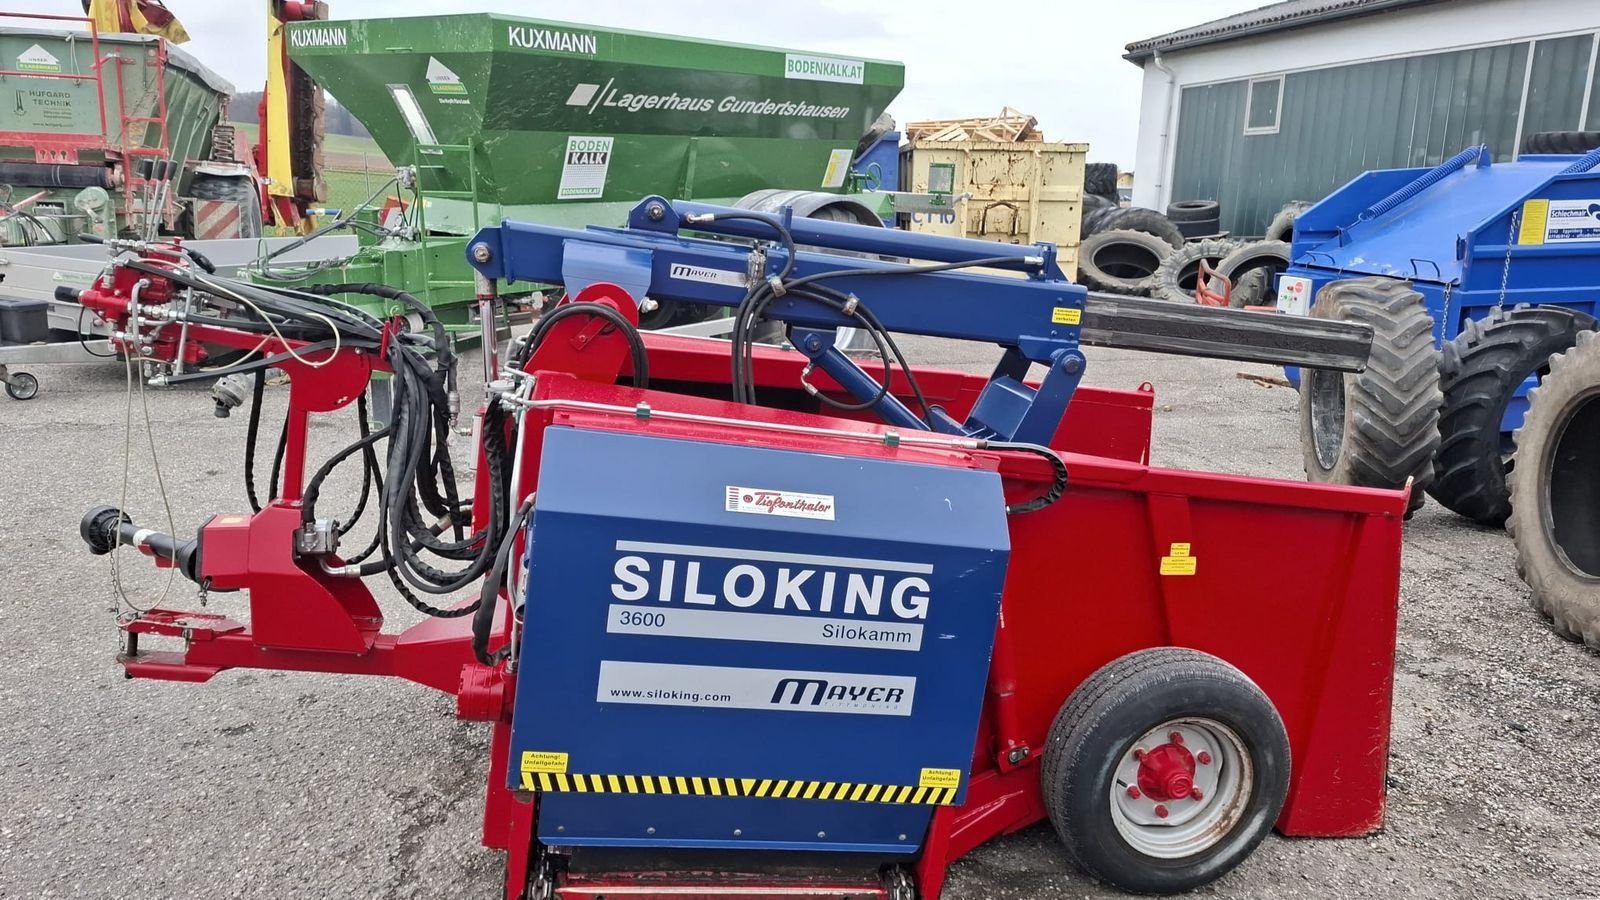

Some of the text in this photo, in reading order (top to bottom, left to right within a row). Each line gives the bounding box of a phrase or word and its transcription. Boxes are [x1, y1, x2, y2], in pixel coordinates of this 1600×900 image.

[290, 28, 347, 47] KUXMANN
[508, 26, 597, 54] KUXMANN
[787, 59, 863, 79] BODENKALK.AT
[29, 90, 71, 98] HUFGARD
[32, 99, 72, 107] TECHNIK
[603, 88, 851, 119] Lagerhaus Gundertshausen
[570, 140, 610, 151] BODEN
[571, 152, 605, 164] KALK
[610, 555, 931, 620] SILOKING
[619, 610, 912, 644] 3600 Silokamm
[610, 688, 731, 703] www.siloking.com
[770, 677, 905, 706] MAYER
